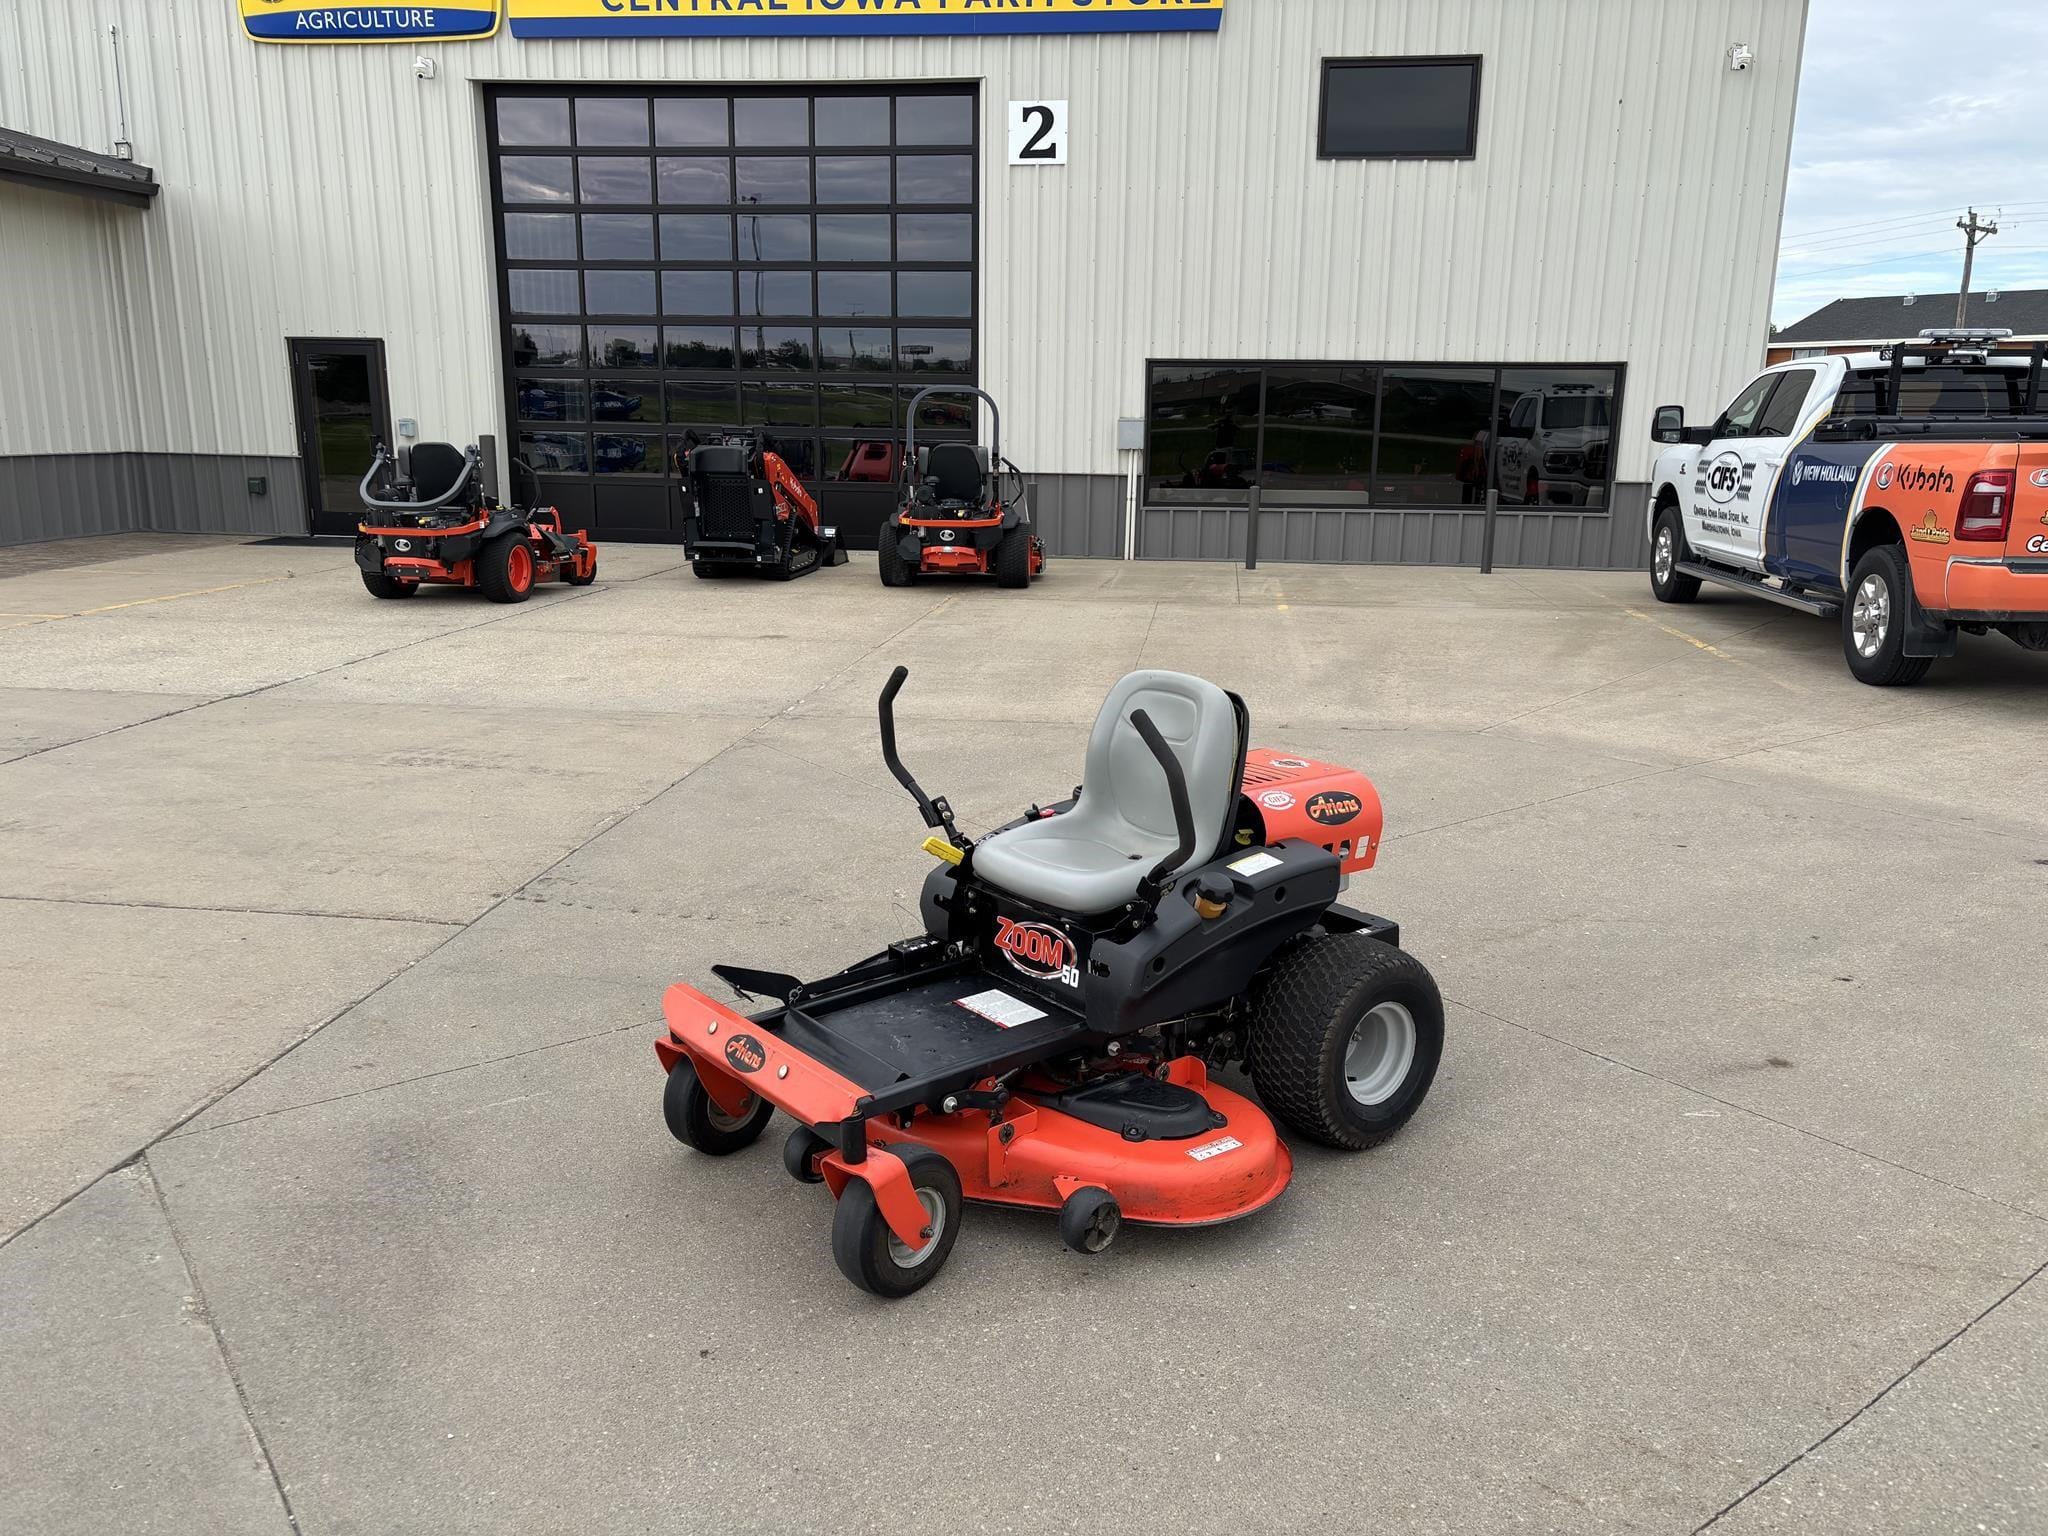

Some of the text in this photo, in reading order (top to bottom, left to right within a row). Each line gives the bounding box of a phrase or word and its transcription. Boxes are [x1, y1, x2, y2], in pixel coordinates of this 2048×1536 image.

[296, 10, 435, 30] AGRICULTURE
[1019, 105, 1056, 159] 2
[1711, 466, 1737, 491] CIFS
[1802, 465, 1857, 482] NEW HOLLAND
[1897, 463, 1954, 493] Kubota
[1310, 796, 1361, 818] Ariens
[994, 916, 1080, 989] ZOOM 50
[727, 1037, 762, 1069] Ariens
